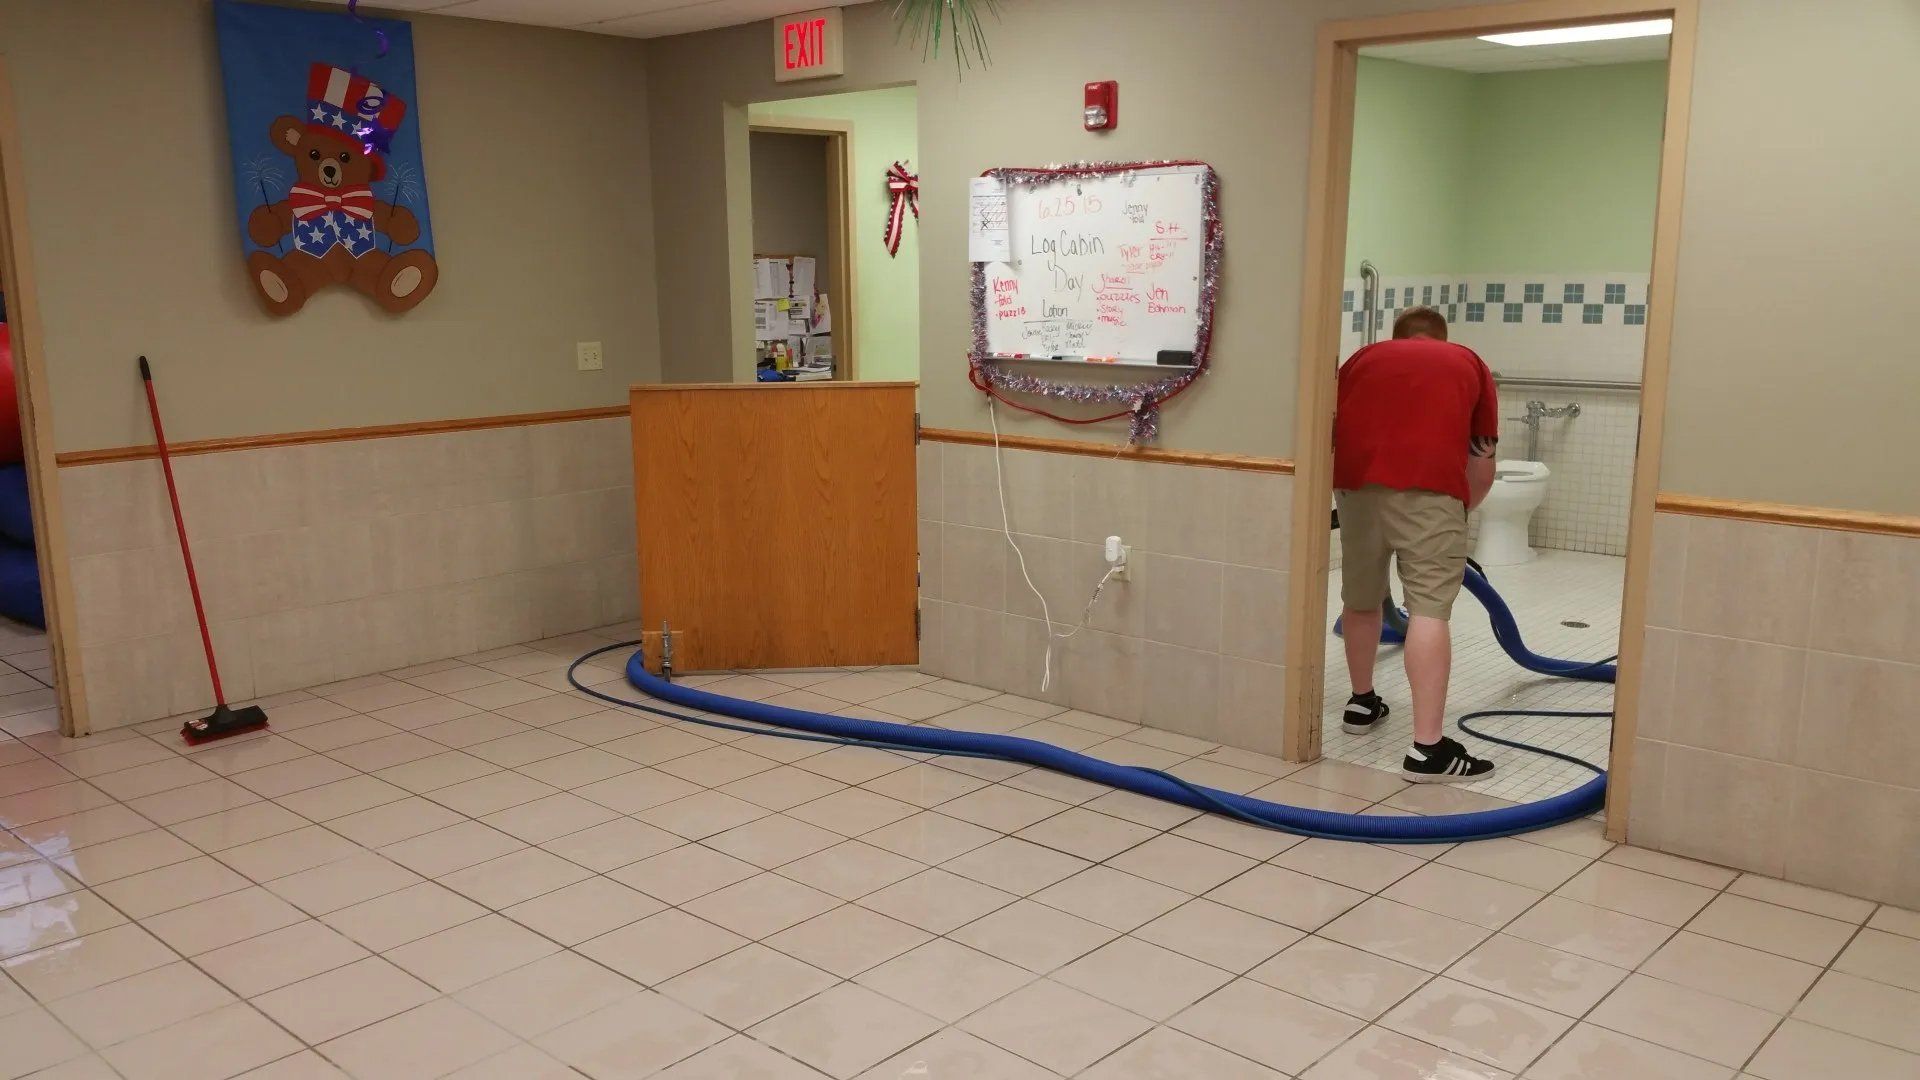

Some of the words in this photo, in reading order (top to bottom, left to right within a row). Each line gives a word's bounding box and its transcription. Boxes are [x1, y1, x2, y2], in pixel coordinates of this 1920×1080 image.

[784, 19, 825, 69] EXIT
[1031, 234, 1057, 271] Log
[1060, 228, 1105, 256] Cabin
[992, 276, 1019, 295] Kenny
[1052, 264, 1084, 303] Day
[1146, 282, 1169, 302] Jen
